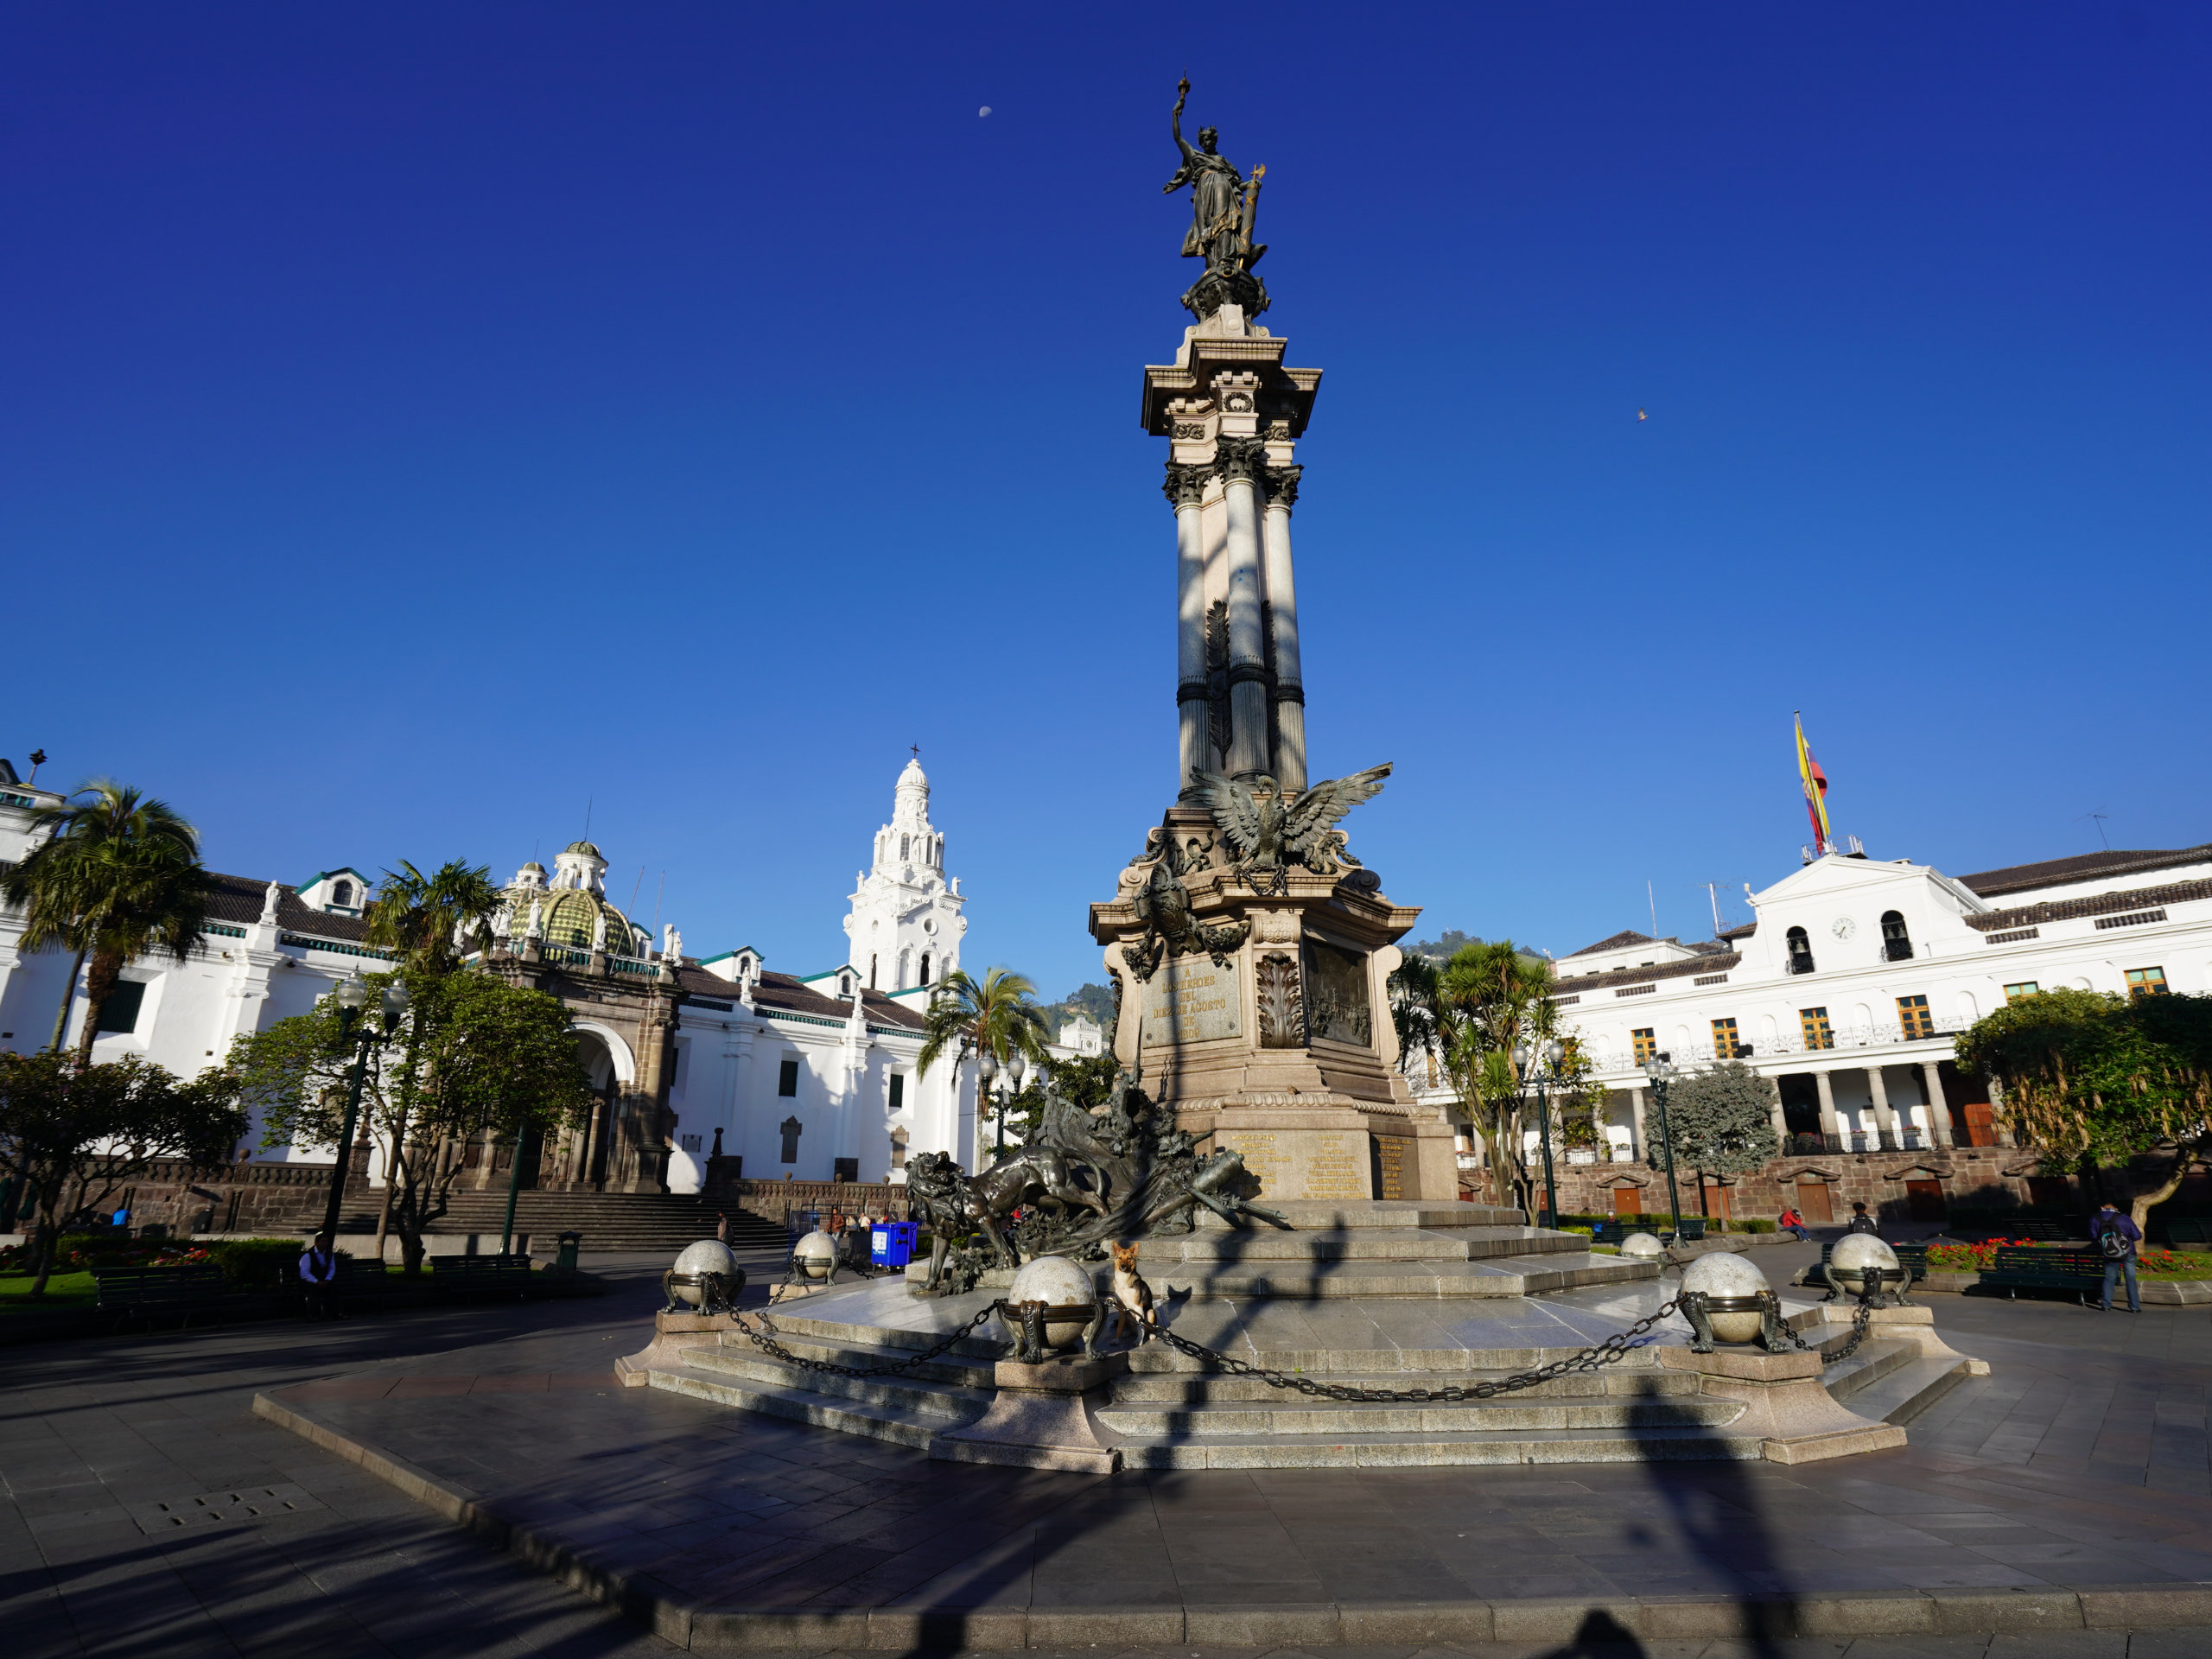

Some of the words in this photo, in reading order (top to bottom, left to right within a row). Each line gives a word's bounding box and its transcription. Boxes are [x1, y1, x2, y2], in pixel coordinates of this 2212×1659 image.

[1185, 968, 1190, 977] A
[1162, 982, 1179, 993] LOS
[1180, 991, 1196, 1002] DEL
[1153, 1007, 1173, 1019] DIEZ
[1176, 1004, 1188, 1016] DE
[1190, 999, 1226, 1014] AGOSTO
[1183, 1016, 1194, 1027] DE
[1179, 1028, 1200, 1039] 1809
